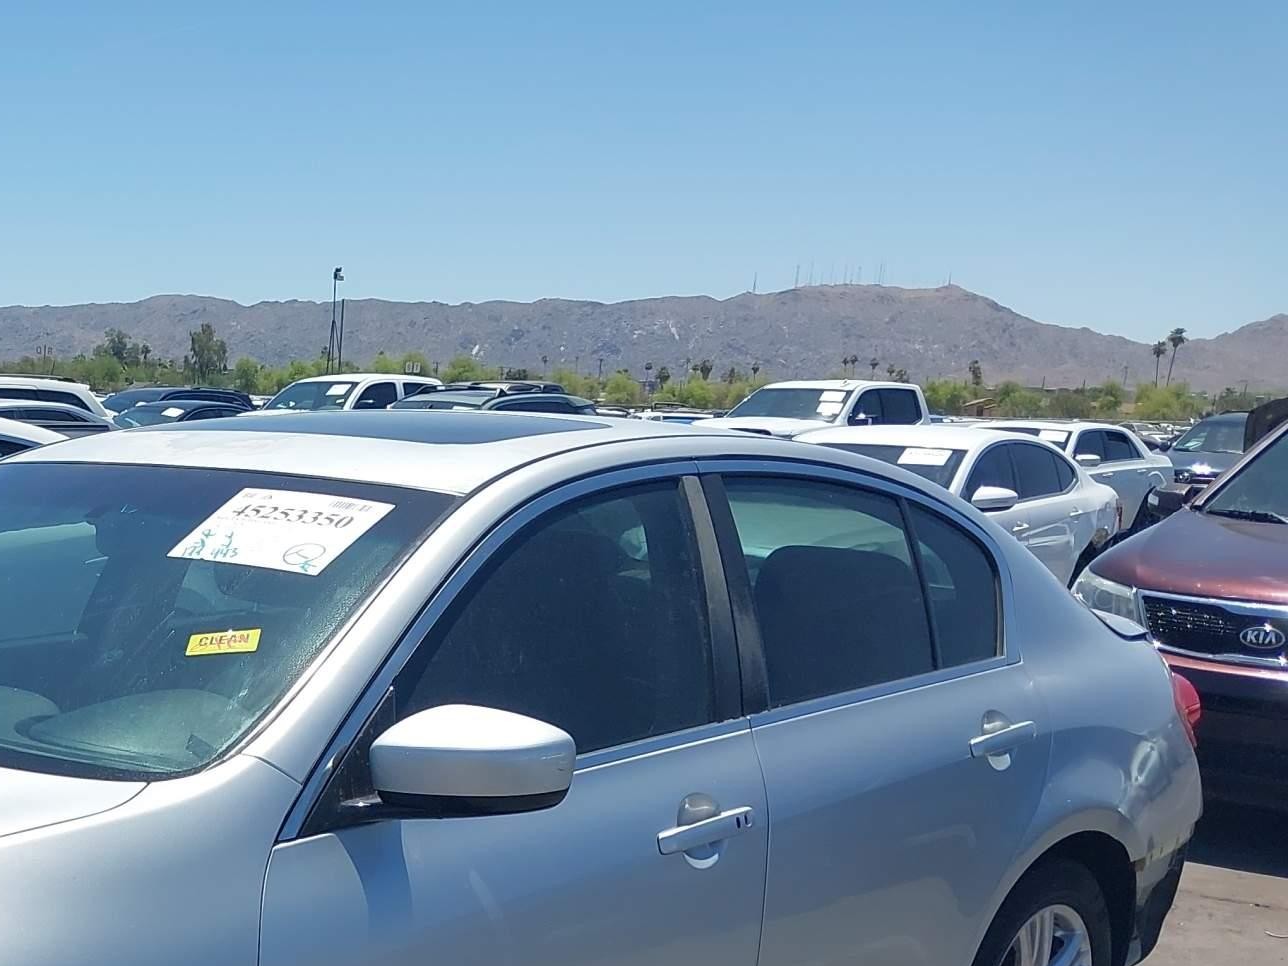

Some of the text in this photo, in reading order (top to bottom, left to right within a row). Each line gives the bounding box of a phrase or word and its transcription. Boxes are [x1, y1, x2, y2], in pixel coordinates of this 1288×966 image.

[232, 504, 354, 529] 45253350
[199, 633, 250, 647] CLEAN
[1246, 630, 1277, 645] KIA
